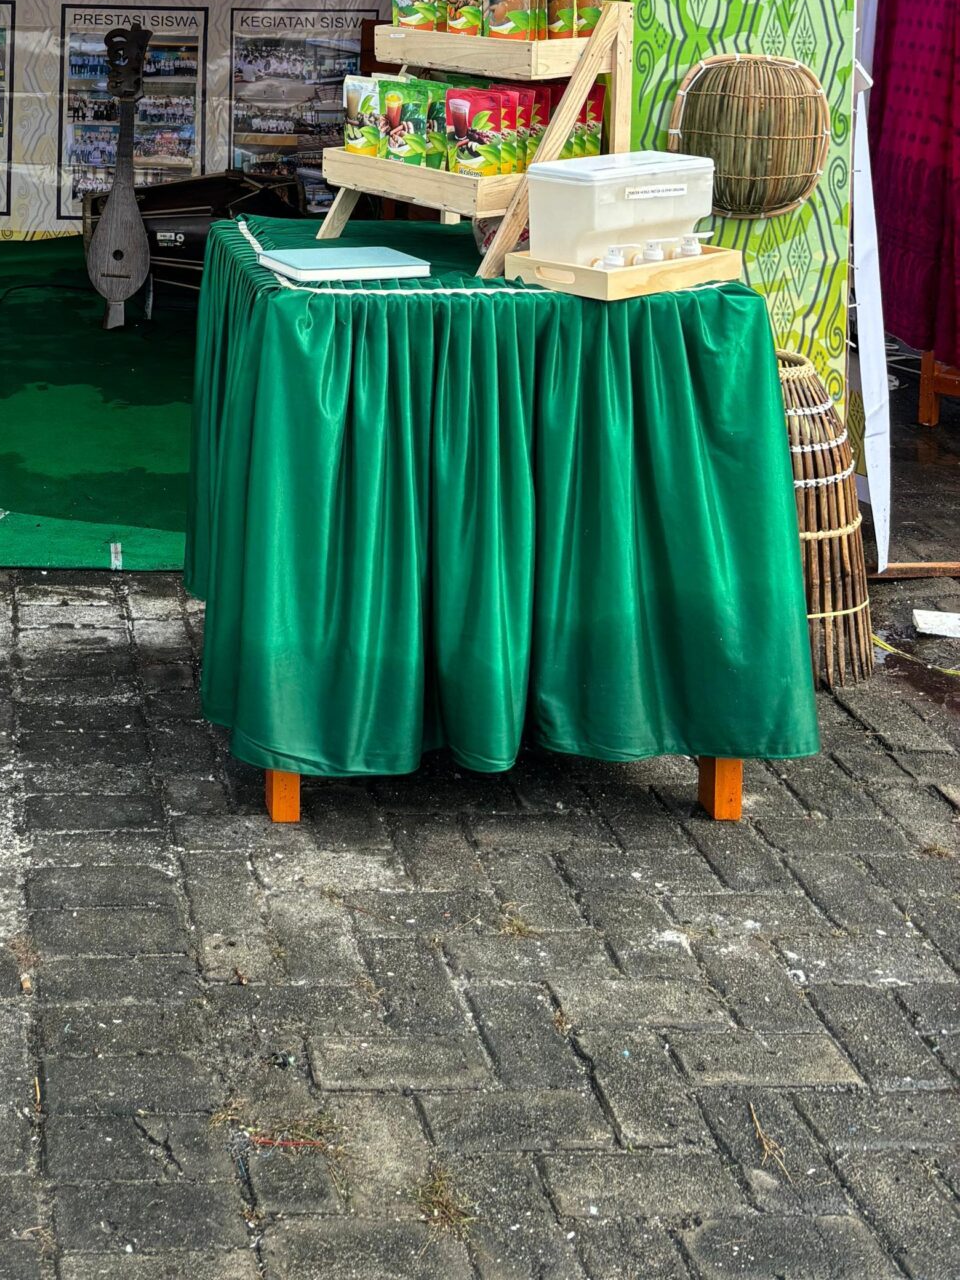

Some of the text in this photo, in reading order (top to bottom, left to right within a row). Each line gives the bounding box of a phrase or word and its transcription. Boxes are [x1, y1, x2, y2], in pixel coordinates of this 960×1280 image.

[73, 13, 198, 28] PRESTASI SISWA
[240, 15, 366, 28] KEGIATAN SISWA
